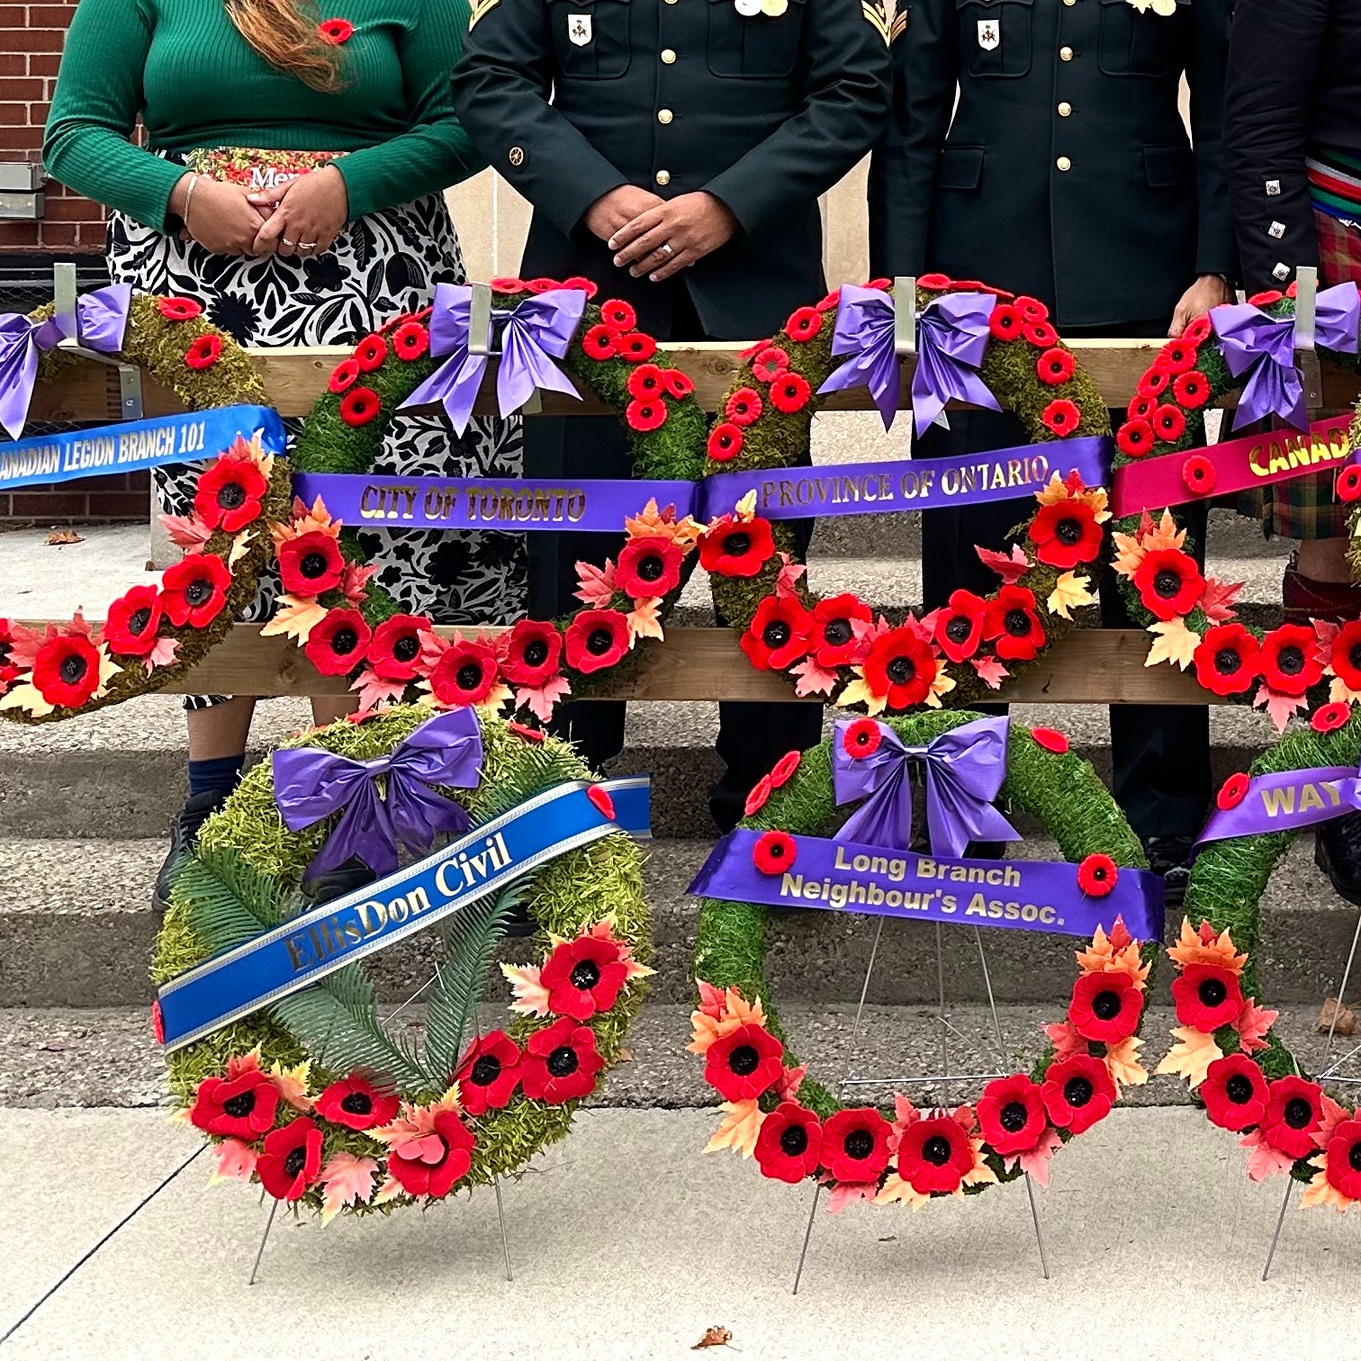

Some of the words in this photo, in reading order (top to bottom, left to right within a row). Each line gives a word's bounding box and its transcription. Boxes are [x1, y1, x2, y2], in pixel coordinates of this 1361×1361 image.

[250, 167, 299, 189] Mer
[0, 444, 60, 480] ANADIAN
[63, 435, 115, 472] LEGION
[117, 428, 175, 465] BRANCH
[178, 421, 206, 452] 101
[1249, 427, 1351, 477] CANAD
[360, 484, 419, 519] CITY
[425, 485, 458, 520] OF
[466, 486, 586, 522] TORONTO
[760, 473, 894, 509] PROVINCE
[901, 470, 935, 500] OF
[942, 455, 1049, 493] ONTARIO
[1260, 782, 1340, 817] WAY
[834, 846, 905, 881] Long
[916, 855, 1021, 888] Branch
[285, 887, 432, 974] EllisDon
[435, 831, 514, 899] Civil
[780, 874, 957, 914] Neighbour's
[964, 894, 1066, 926] Assoc.
